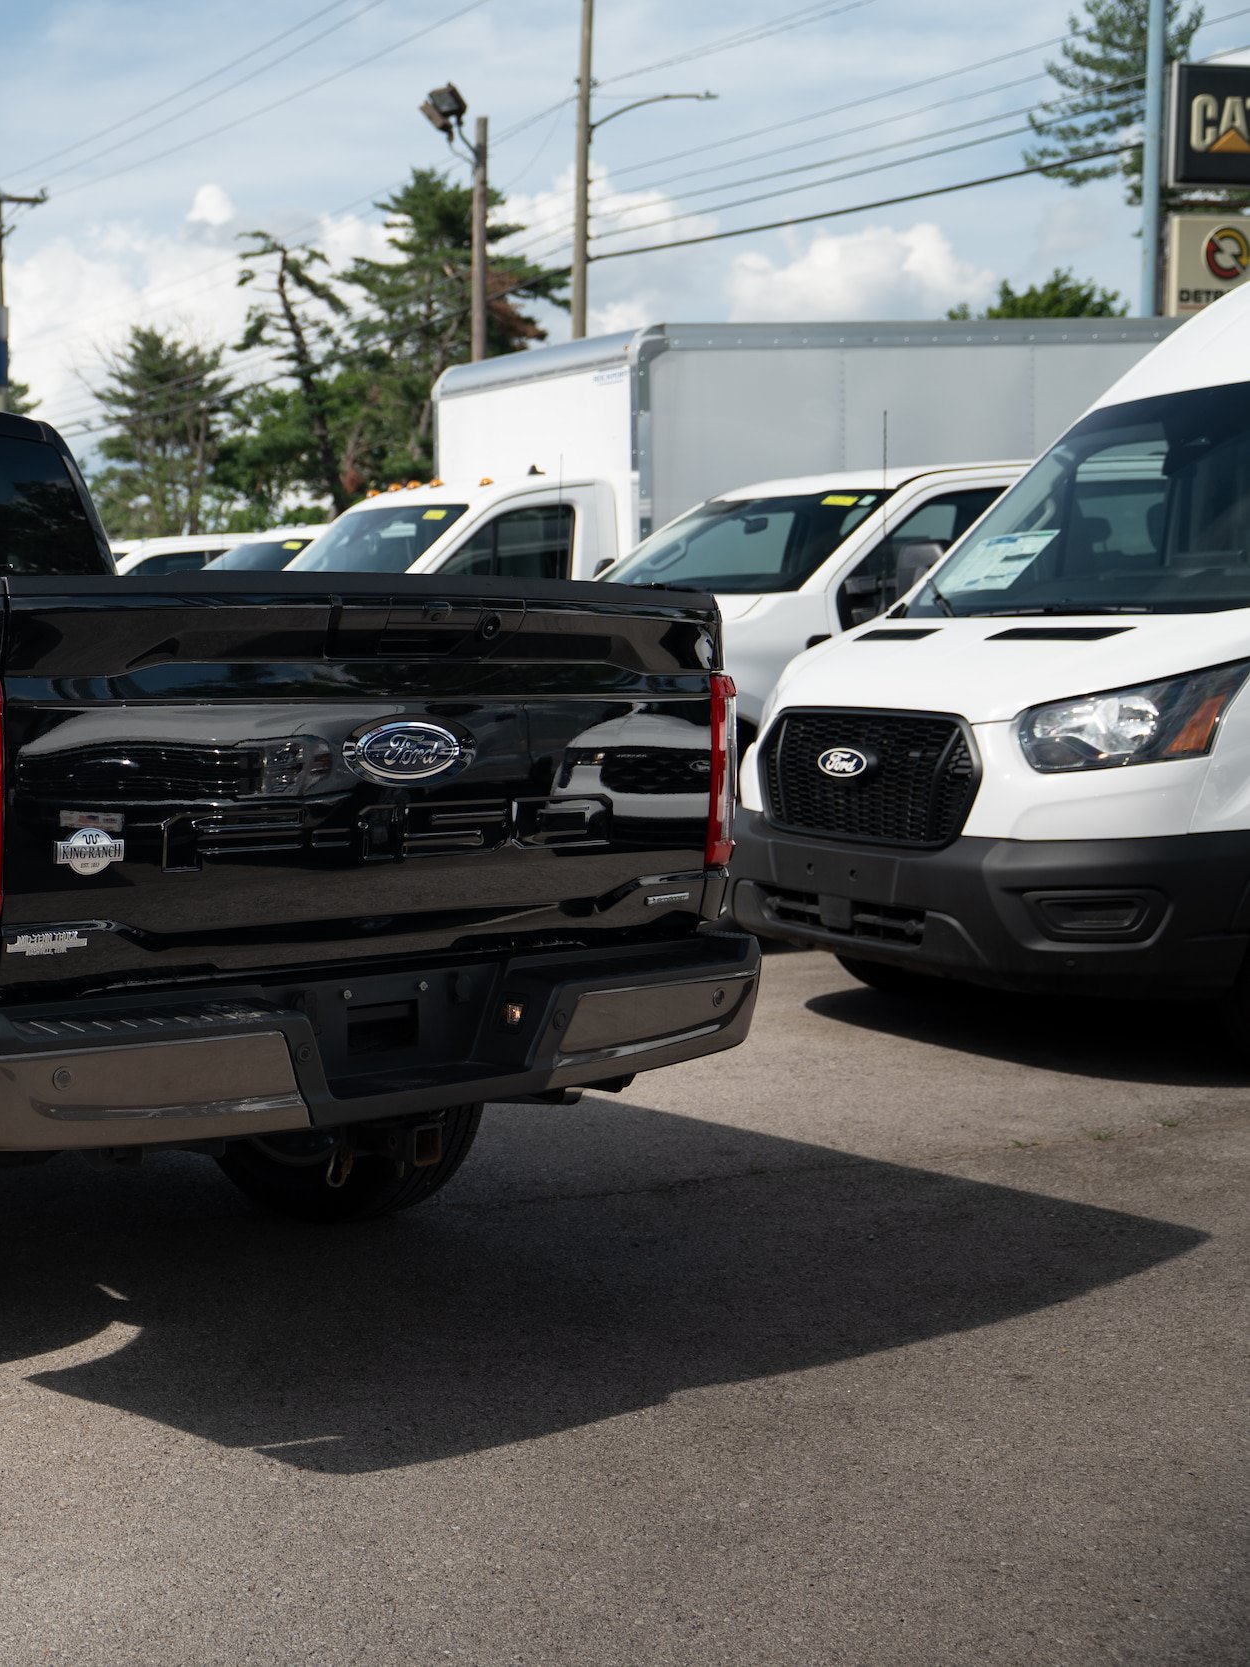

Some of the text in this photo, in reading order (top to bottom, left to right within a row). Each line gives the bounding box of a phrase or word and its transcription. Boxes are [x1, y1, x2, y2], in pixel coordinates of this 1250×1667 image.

[1190, 94, 1250, 151] CA
[383, 733, 439, 766] Ford
[825, 751, 858, 772] Ford
[160, 794, 613, 873] F-150
[61, 844, 121, 860] KING RANCH
[16, 930, 79, 945] MID-TENN TRUCK
